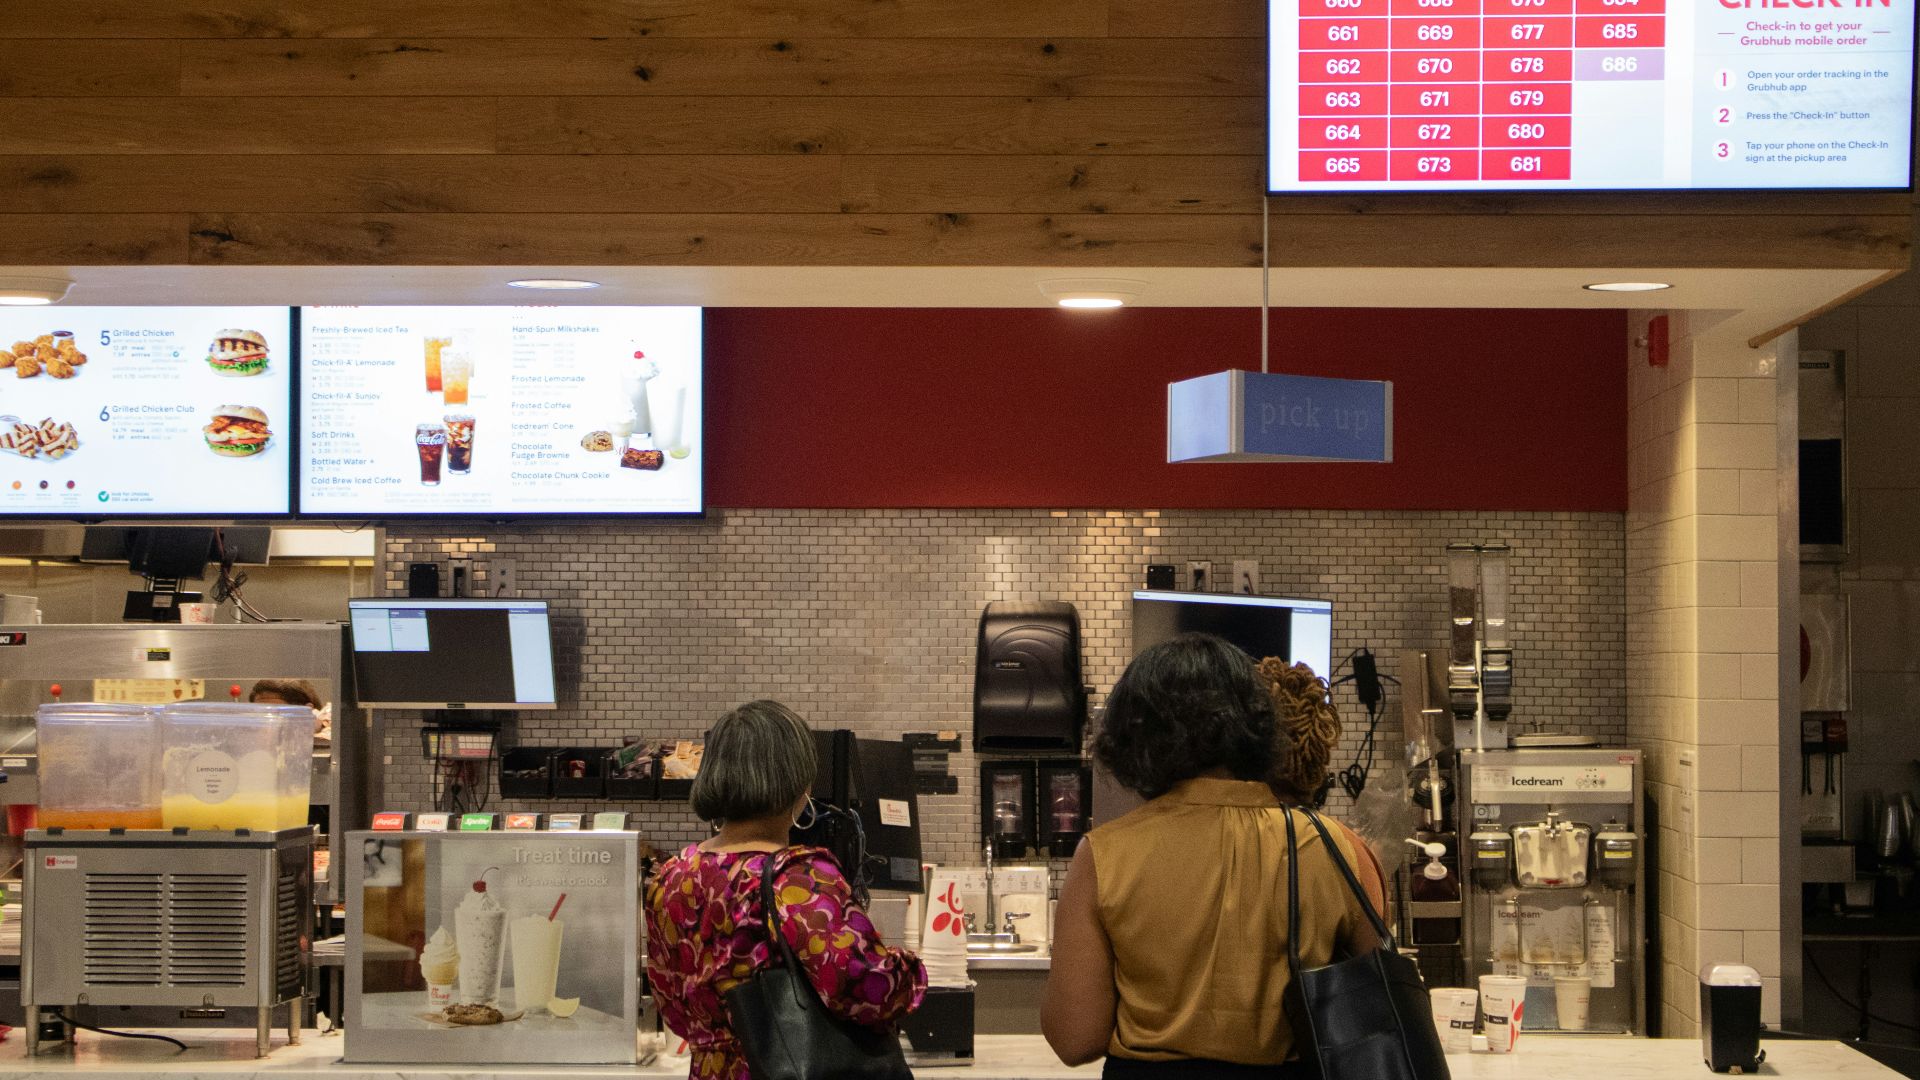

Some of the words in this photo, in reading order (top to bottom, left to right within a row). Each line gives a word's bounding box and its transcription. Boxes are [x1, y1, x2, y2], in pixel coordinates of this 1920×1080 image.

[1328, 26, 1359, 41] 661
[1418, 25, 1453, 40] 669
[1511, 24, 1544, 40] 677
[1602, 24, 1637, 39] 685
[1746, 21, 1796, 31] Check-in
[1800, 22, 1810, 30] to
[1815, 22, 1832, 32] get
[1836, 23, 1862, 32] your
[1740, 36, 1791, 46] Grubhub
[1795, 36, 1833, 45] mobile
[1836, 36, 1867, 45] order
[1326, 59, 1360, 74] 662
[1418, 58, 1452, 74] 670
[1510, 58, 1544, 73] 678
[1602, 57, 1637, 72] 686
[1722, 72, 1727, 87] 1
[1748, 71, 1772, 80] Open
[1774, 72, 1796, 80] your
[1798, 70, 1821, 78] order
[1824, 70, 1861, 80] tracking
[1863, 70, 1872, 78] in
[1874, 70, 1888, 78] the
[1747, 83, 1787, 92] Grubhub
[1790, 84, 1807, 92] app
[1325, 92, 1360, 107] 663
[1420, 92, 1449, 106] 671
[1510, 91, 1544, 106] 679
[1719, 108, 1730, 122] 2
[1746, 112, 1770, 120] Press
[1325, 125, 1360, 140] 664
[1418, 125, 1451, 140] 672
[1508, 124, 1545, 139] 680
[1718, 143, 1729, 158] 3
[1746, 142, 1762, 151] Tap
[1764, 143, 1784, 151] your
[1786, 142, 1815, 151] phone
[1831, 141, 1846, 149] the
[1848, 141, 1888, 149] Check-In
[1325, 158, 1360, 173] 665
[1418, 157, 1451, 172] 673
[1510, 157, 1541, 172] 681
[1746, 154, 1764, 163] sign
[1794, 154, 1825, 162] pickup
[100, 330, 111, 346] 5
[113, 329, 140, 337] Grilled
[142, 329, 174, 337] Chicken
[100, 406, 110, 421] 6
[1261, 398, 1319, 433] pick
[1334, 408, 1368, 440] up
[511, 452, 535, 460] Fudge
[464, 817, 489, 826] Sprite
[512, 846, 561, 865] Treat
[568, 846, 612, 865] time
